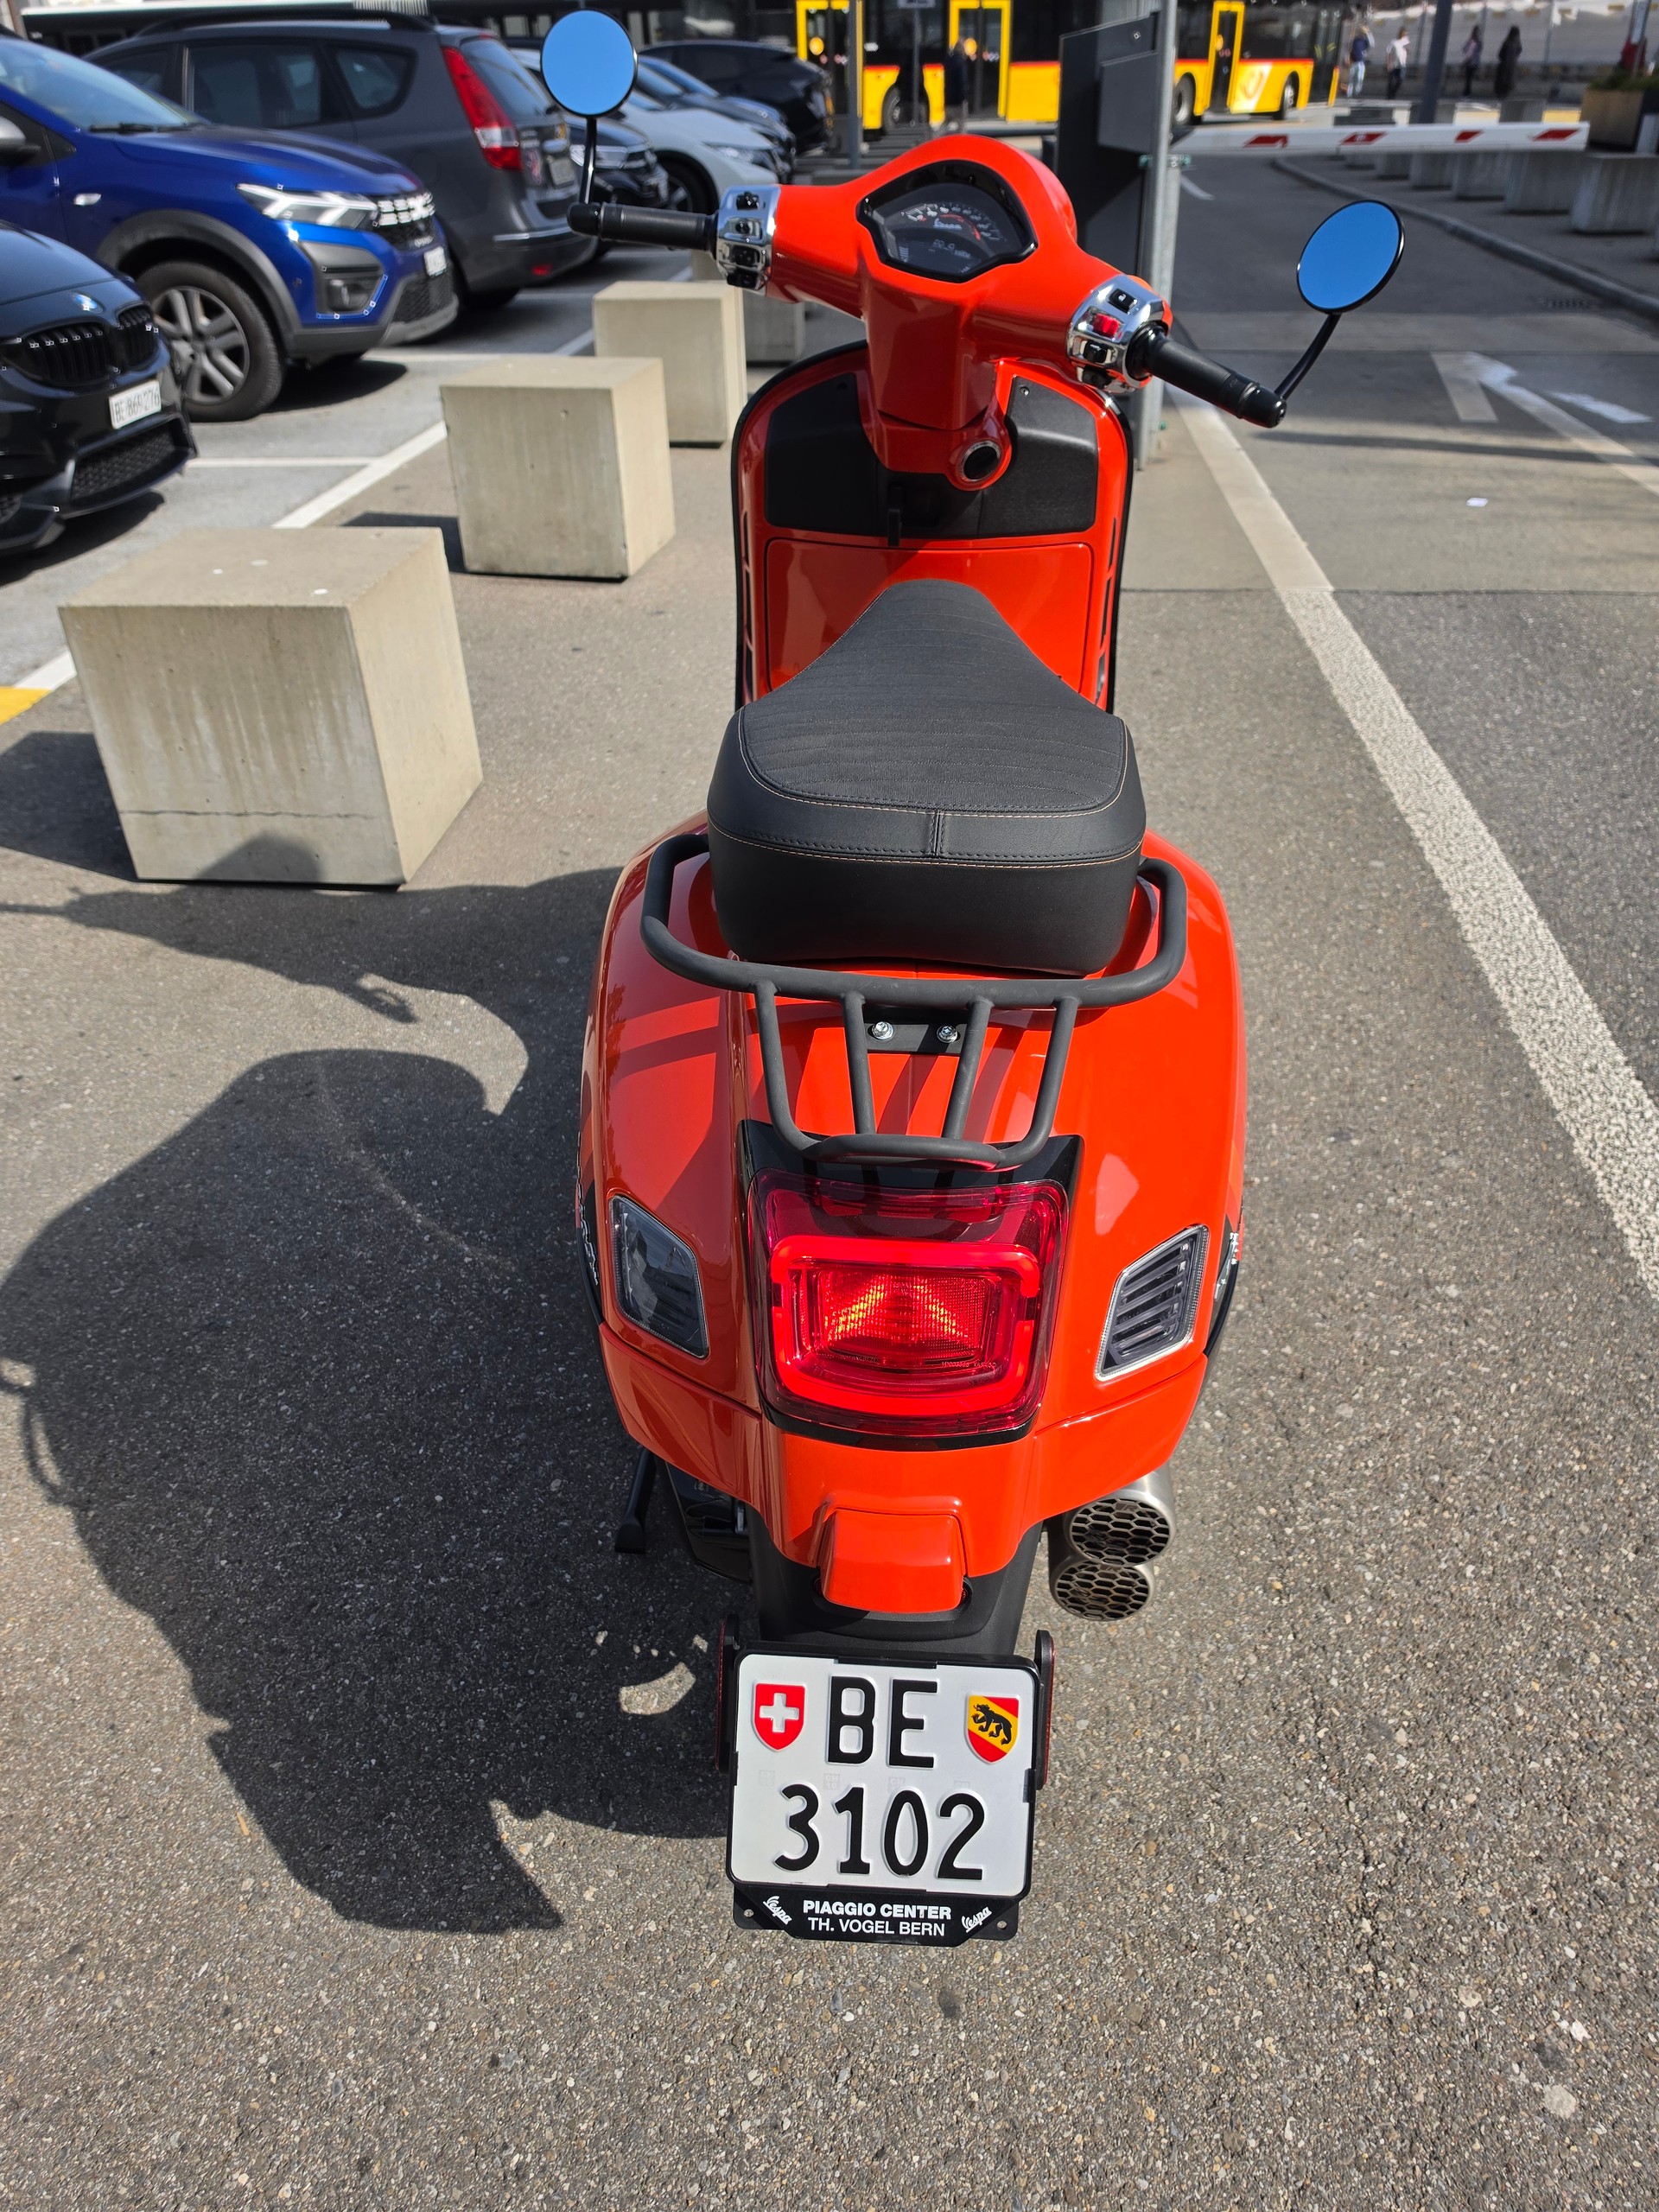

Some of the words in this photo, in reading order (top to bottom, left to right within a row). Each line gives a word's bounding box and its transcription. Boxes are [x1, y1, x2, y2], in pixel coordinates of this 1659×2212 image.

[827, 1675, 938, 1769] BE
[774, 1784, 985, 1881] 3102
[763, 1896, 792, 1925] Vespa
[803, 1899, 876, 1916] PIAGGIO
[880, 1904, 951, 1920] CENTER
[961, 1906, 992, 1933] Vespa
[807, 1916, 835, 1932] TH.
[838, 1917, 895, 1935] VOGEL
[899, 1921, 945, 1936] BERN
